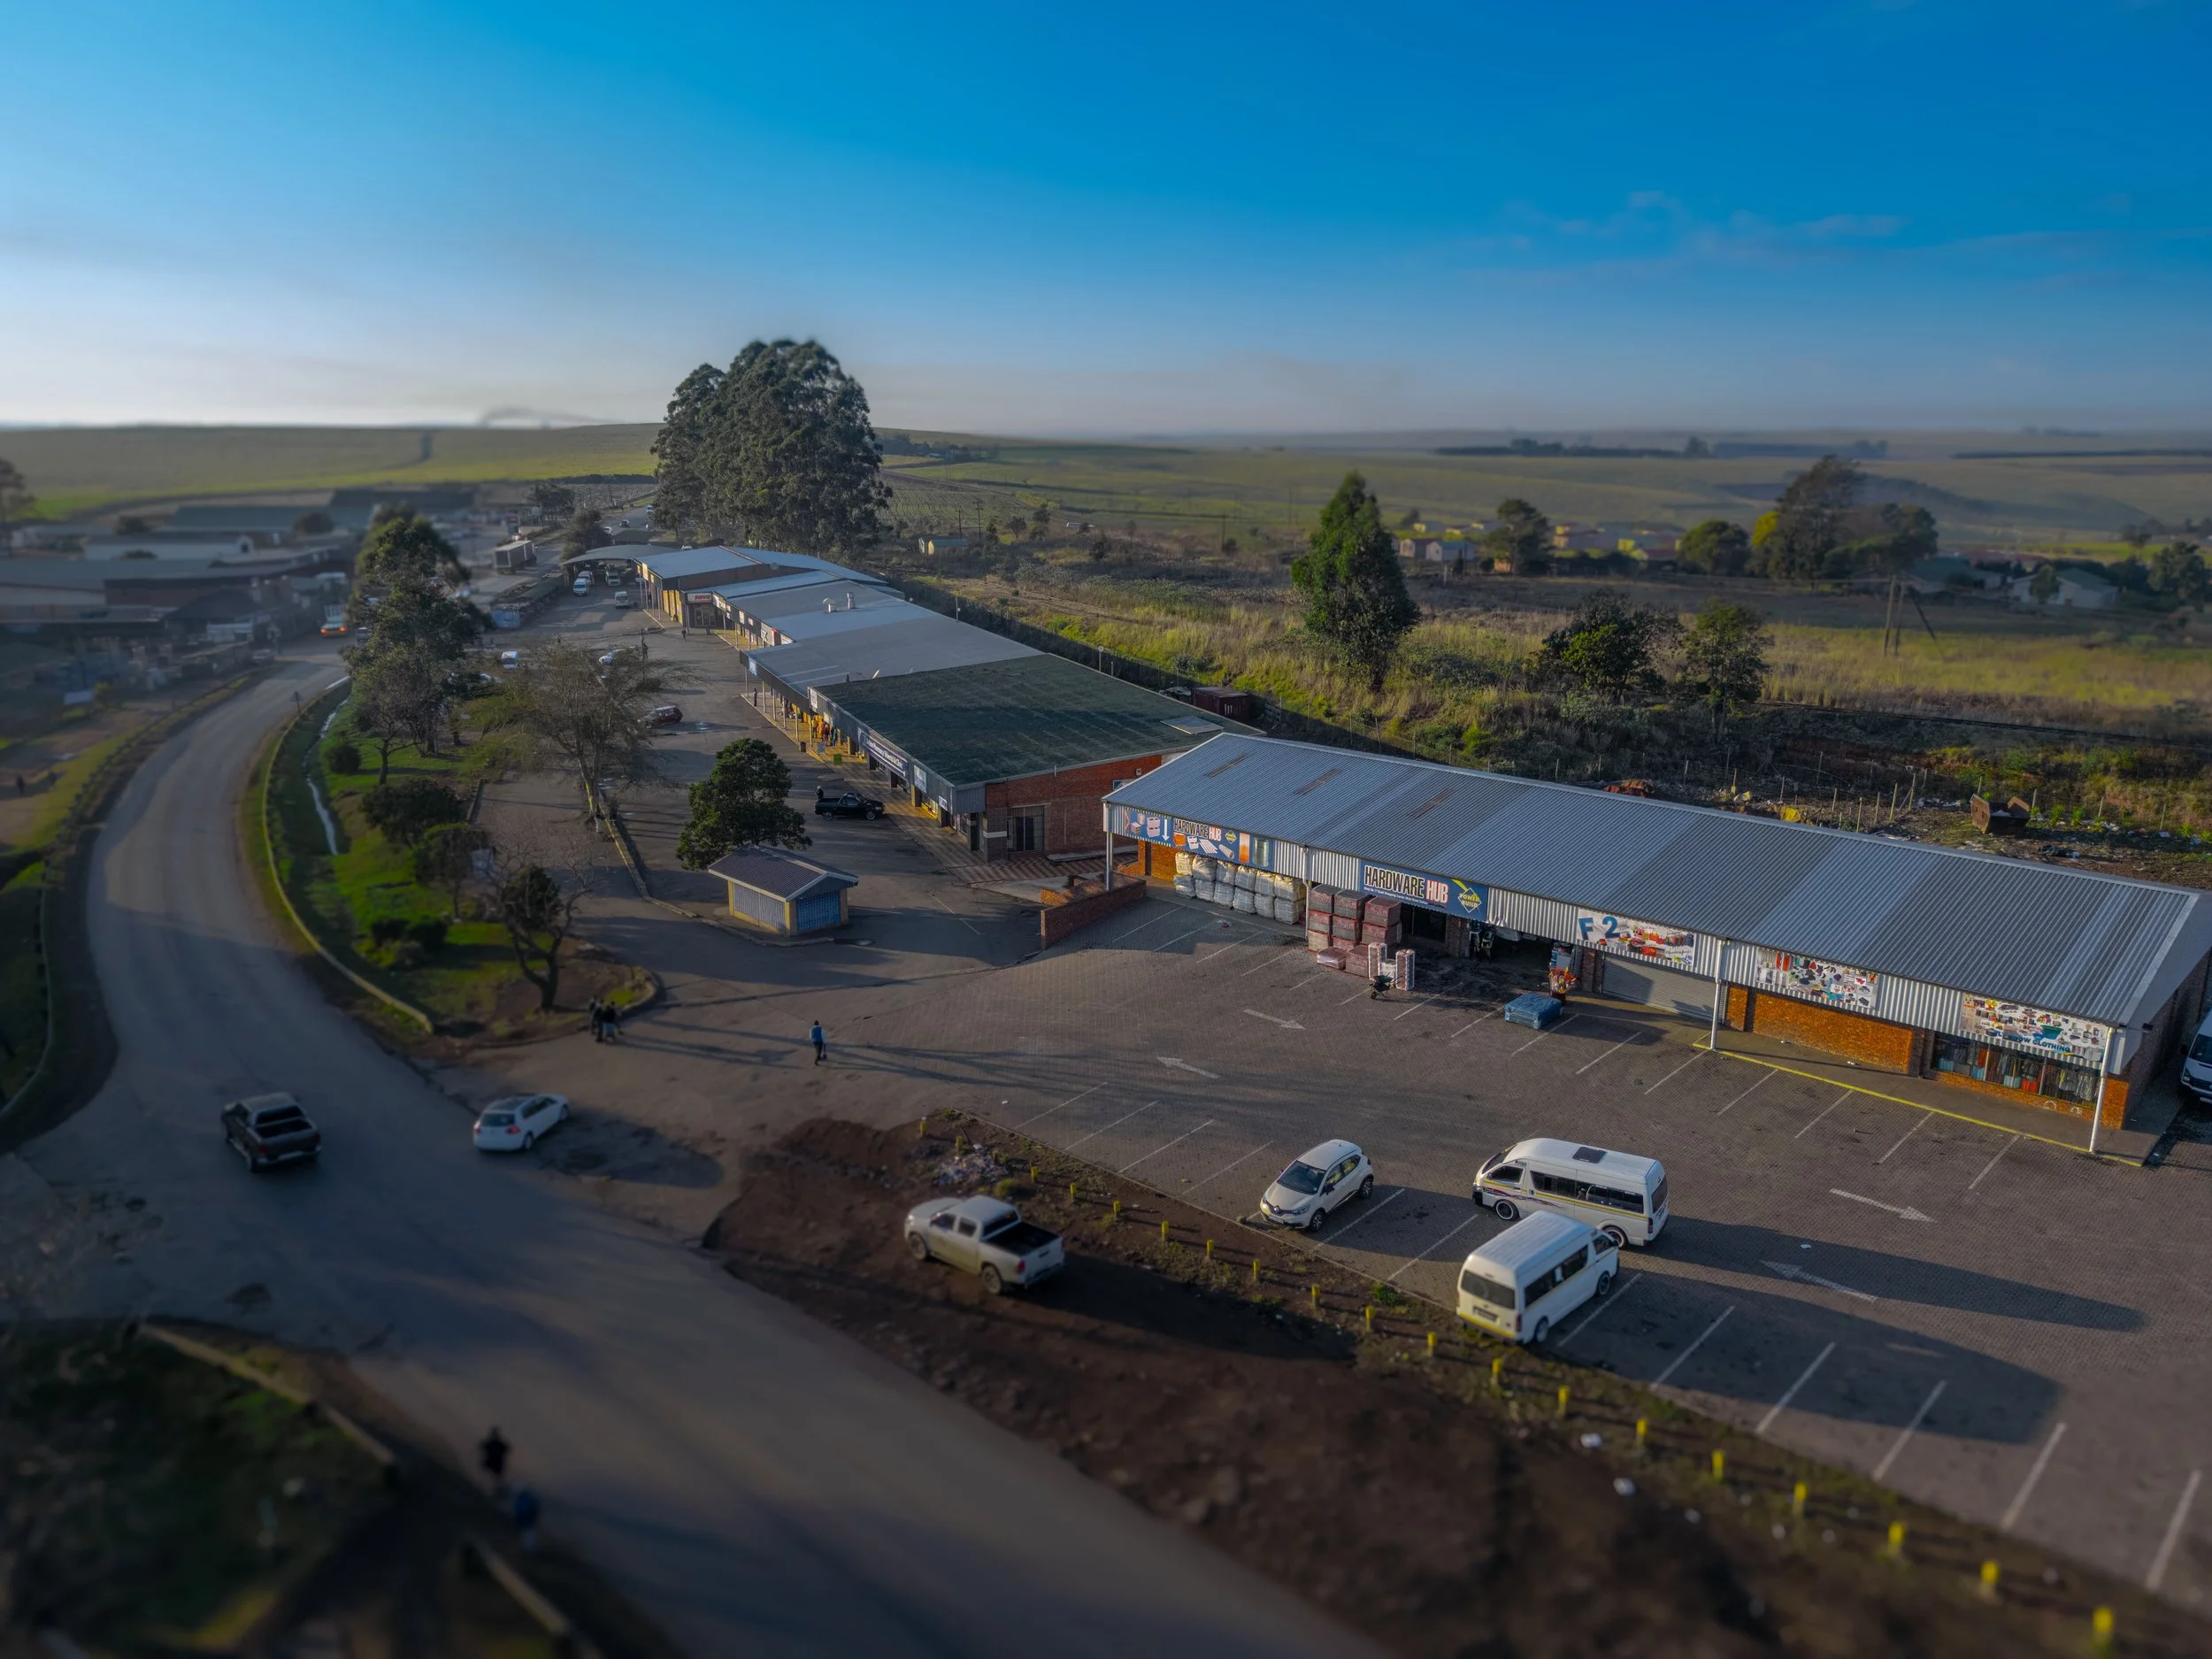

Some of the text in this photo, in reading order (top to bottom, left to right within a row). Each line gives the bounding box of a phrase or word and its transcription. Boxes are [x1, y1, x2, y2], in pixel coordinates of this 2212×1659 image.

[1173, 818, 1209, 840] HARDWARE
[1209, 826, 1222, 841] HUB
[1364, 865, 1448, 903] HARDWARE HUB
[1459, 893, 1479, 902] POWER
[1578, 916, 1621, 941] F 2
[2032, 1039, 2070, 1052] CLOTHING
